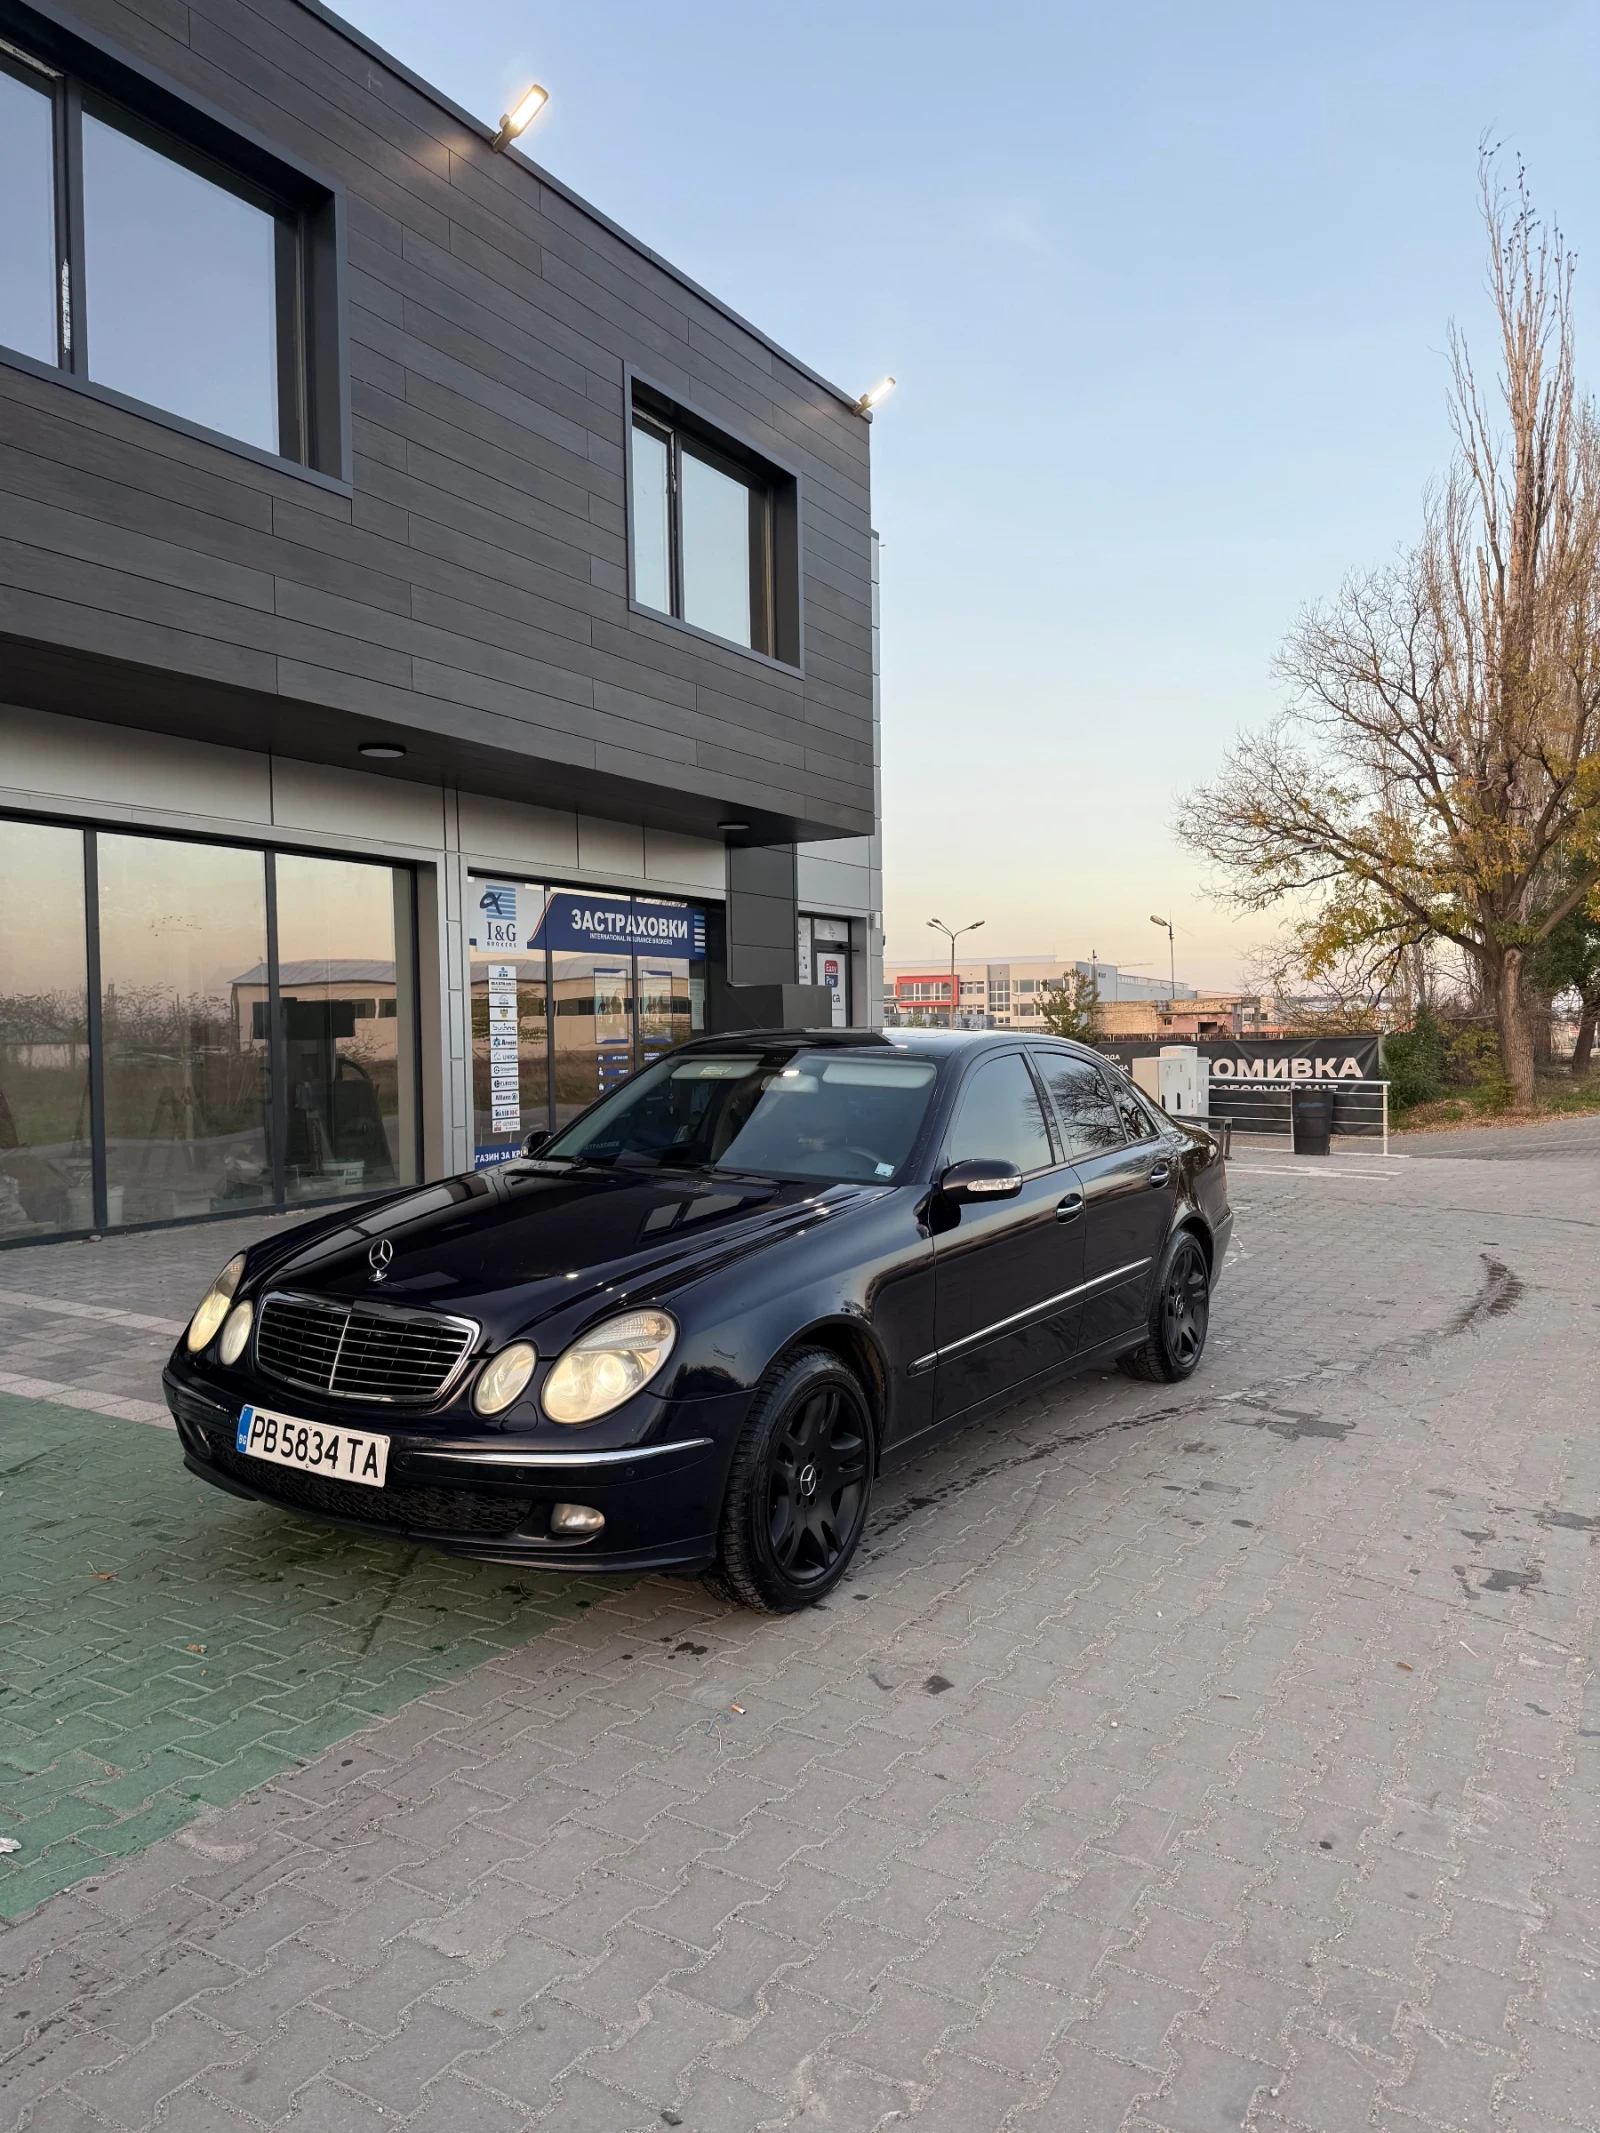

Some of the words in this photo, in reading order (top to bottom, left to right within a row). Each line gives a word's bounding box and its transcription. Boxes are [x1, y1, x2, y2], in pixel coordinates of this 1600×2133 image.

[571, 908, 688, 939] ЗАСТРАХОВКИ
[486, 921, 517, 942] I&G
[589, 932, 626, 942] INTERNATIONAL
[652, 938, 673, 946] BROKERS
[501, 1151, 511, 1160] ЗА
[238, 1433, 248, 1445] BG
